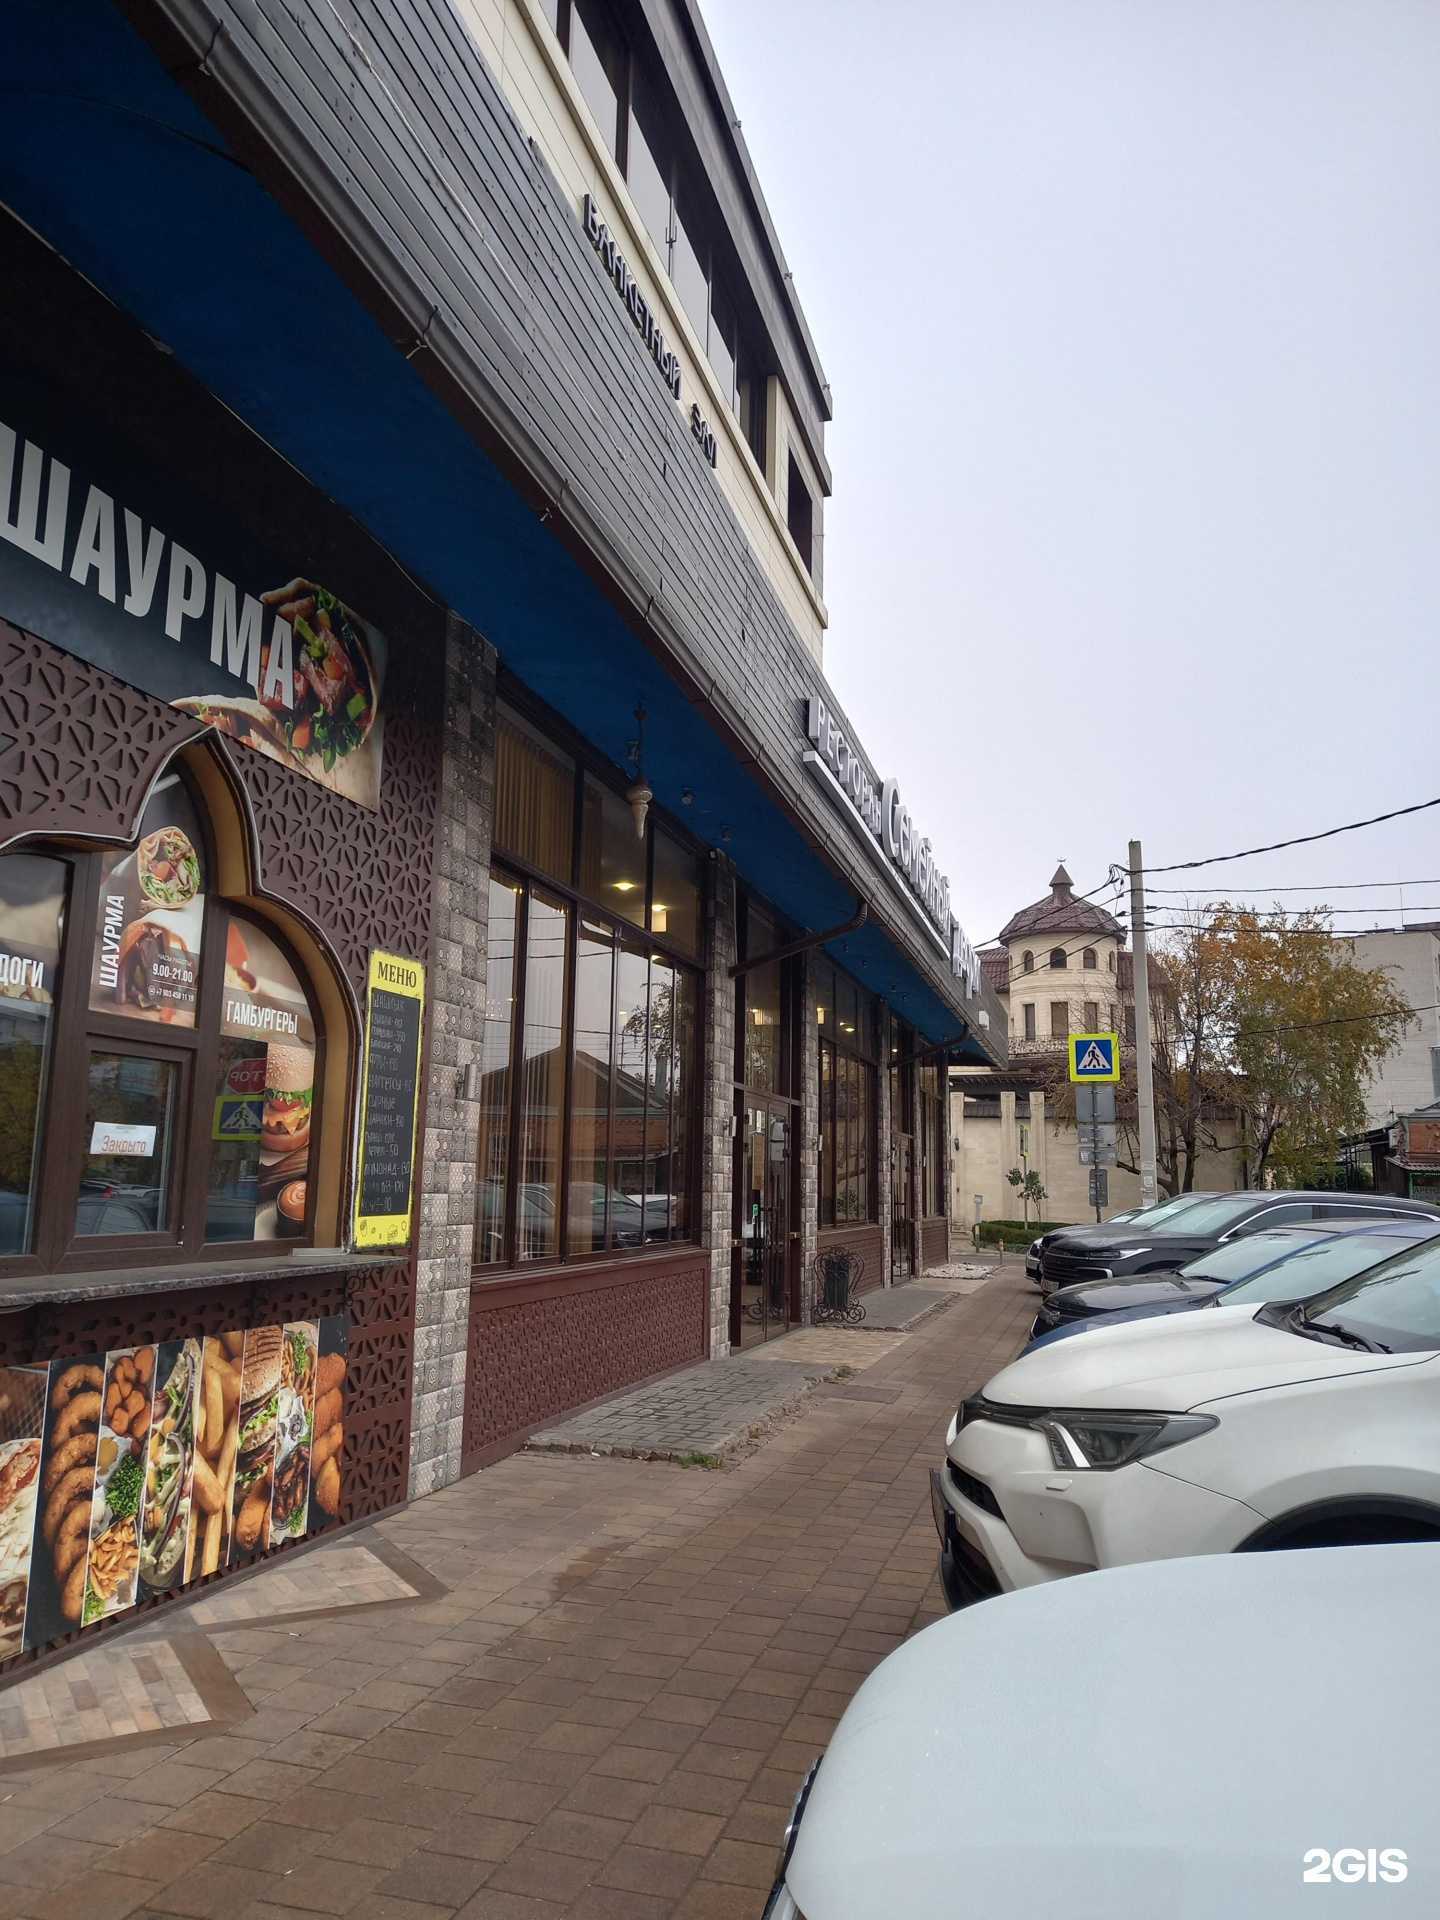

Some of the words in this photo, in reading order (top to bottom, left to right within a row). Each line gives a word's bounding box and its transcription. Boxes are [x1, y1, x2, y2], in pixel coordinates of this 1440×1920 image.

[583, 193, 681, 400] БАНКЕТНЫЙ
[691, 403, 717, 469] ЗАЛ
[0, 420, 294, 711] ШАУРМА
[807, 696, 881, 836] РЕСТОРАН
[99, 895, 124, 988] ШАУРМА
[152, 963, 193, 983] 9.00-21.00
[377, 960, 417, 988] МЕНЮ
[226, 1000, 299, 1035] ГАМБУРГЕРЫ
